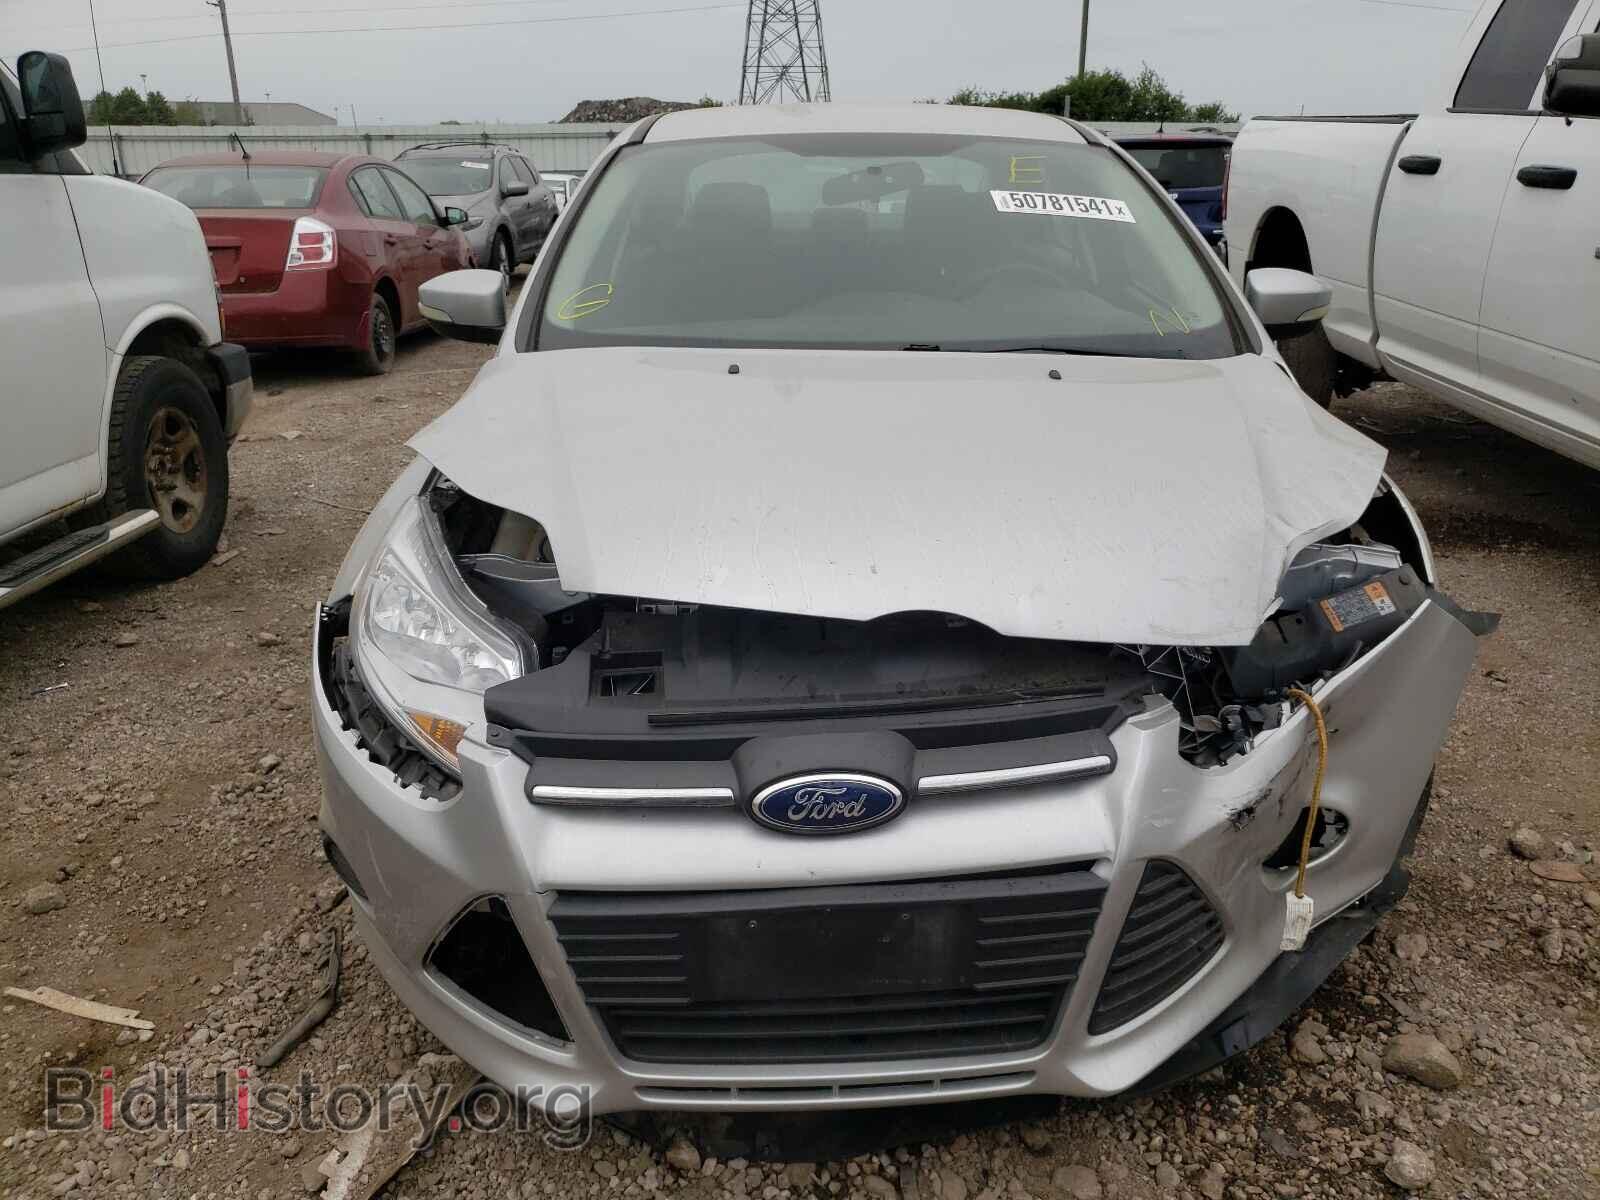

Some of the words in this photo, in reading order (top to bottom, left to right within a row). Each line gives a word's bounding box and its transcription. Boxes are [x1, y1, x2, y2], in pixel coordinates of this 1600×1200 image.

[1008, 155, 1047, 184] E
[1008, 192, 1113, 215] 50781541
[787, 787, 868, 821] Ford
